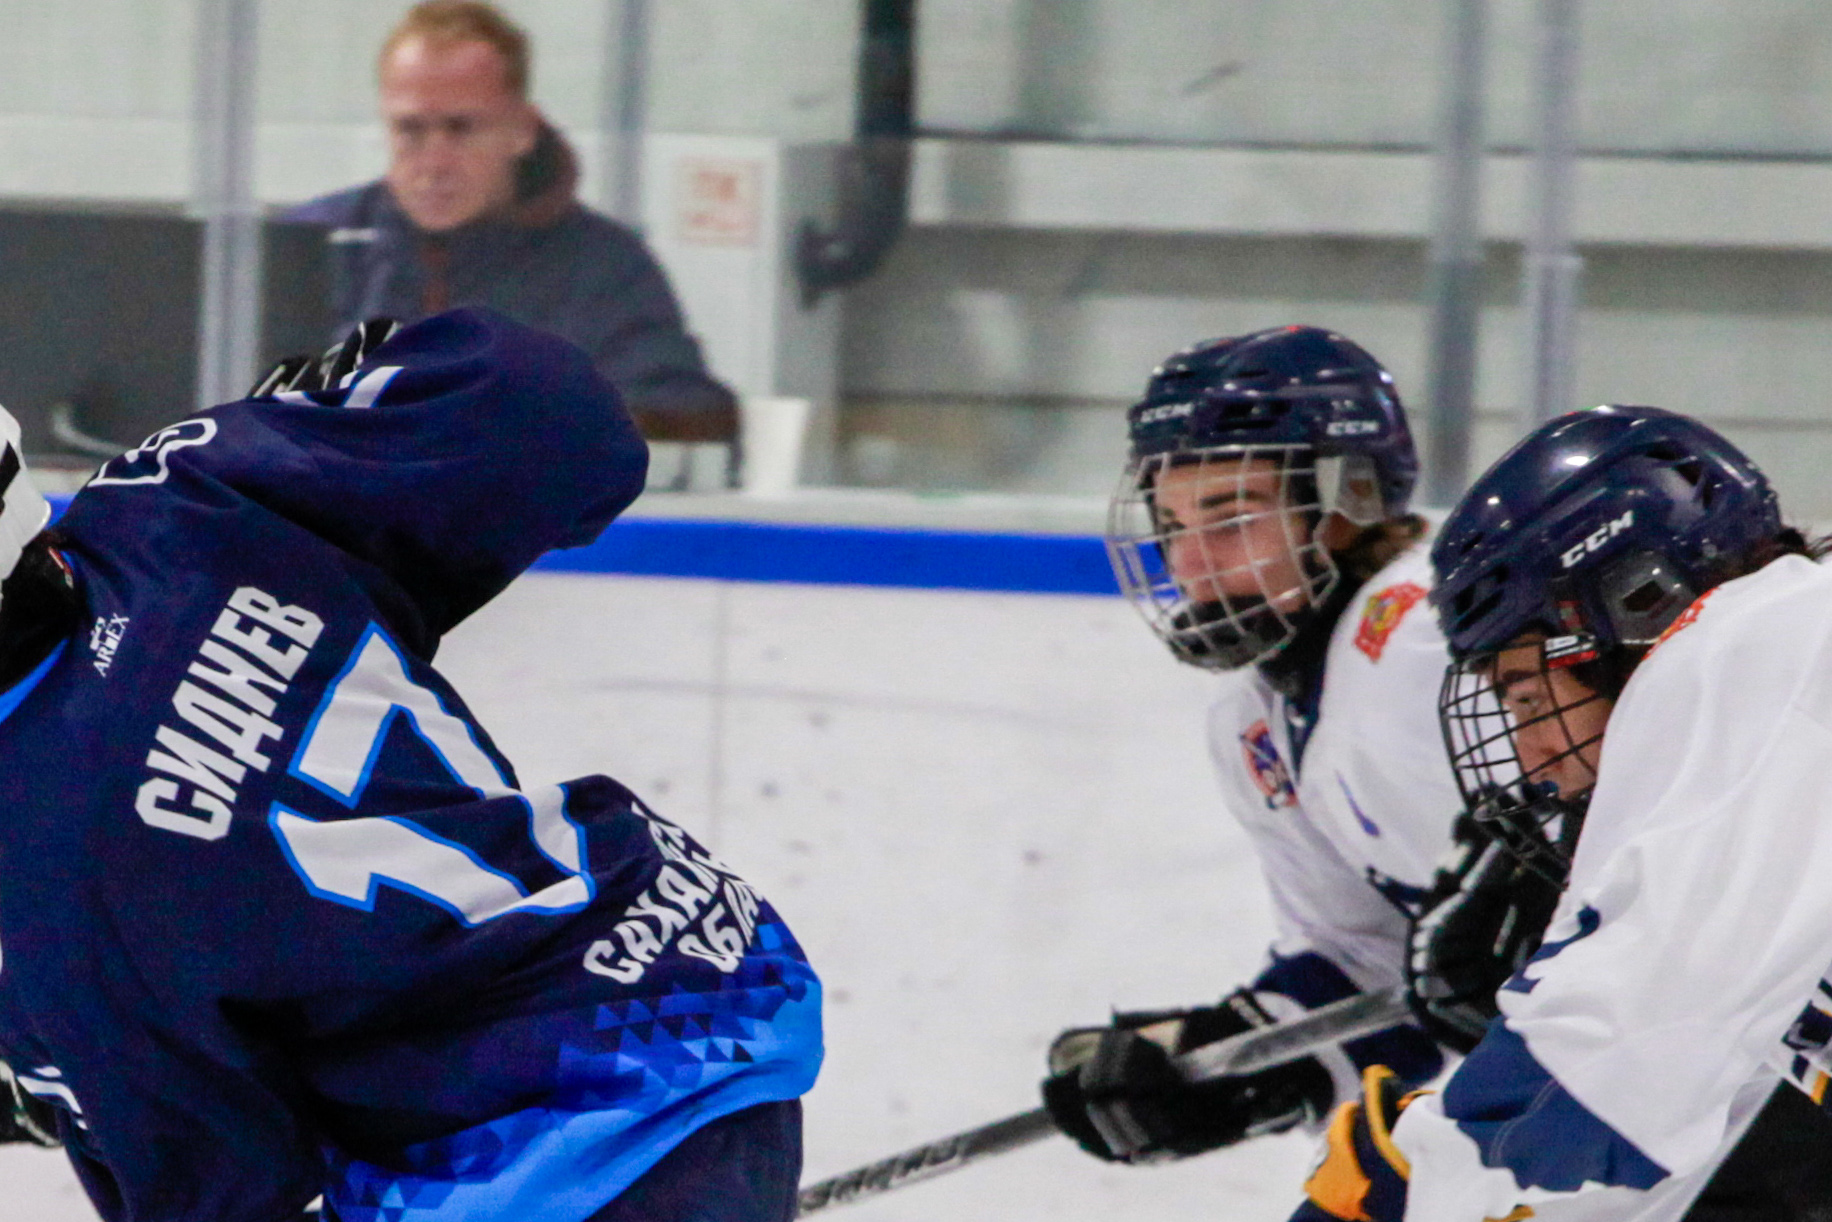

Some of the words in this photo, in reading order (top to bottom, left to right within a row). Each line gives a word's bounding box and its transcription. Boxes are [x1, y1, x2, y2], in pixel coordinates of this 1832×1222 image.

[1560, 509, 1634, 569] CCM
[134, 586, 325, 842] СИДНЕВ
[268, 620, 597, 929] 17
